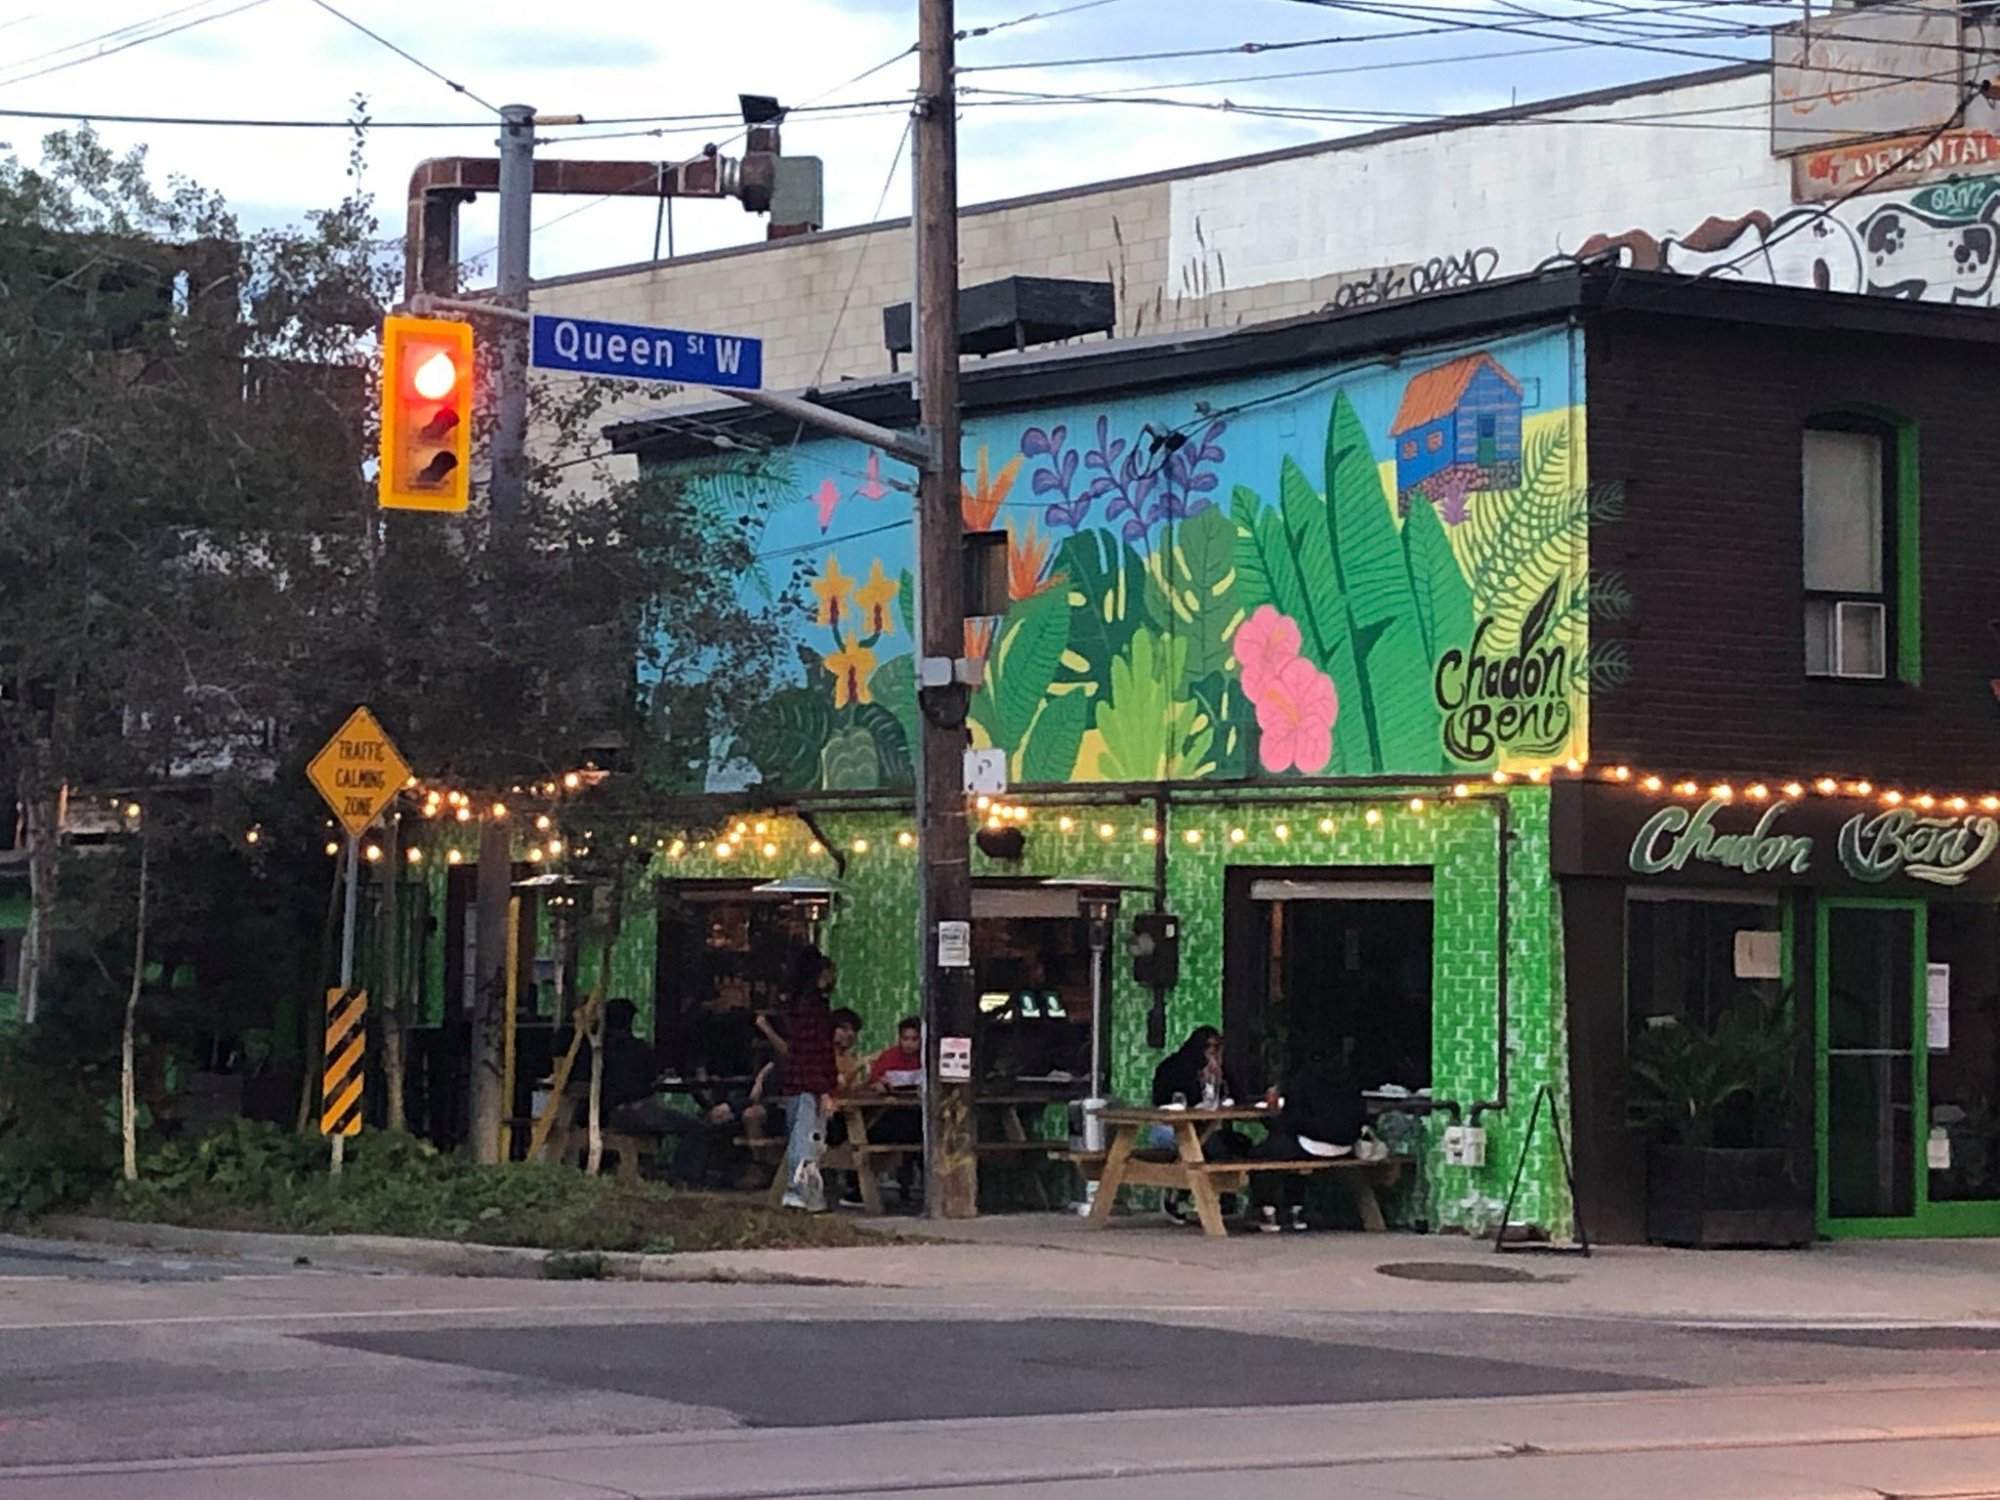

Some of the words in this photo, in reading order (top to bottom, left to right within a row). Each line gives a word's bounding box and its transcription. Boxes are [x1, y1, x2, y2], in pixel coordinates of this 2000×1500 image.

[554, 321, 673, 368] Queen
[687, 335, 705, 355] St
[715, 338, 742, 375] W
[1435, 574, 1565, 710] Chadon
[337, 740, 385, 762] TRAFFIC
[1444, 702, 1571, 762] Beni
[335, 768, 385, 790] CALMING
[343, 796, 374, 816] ZONE
[1630, 799, 1813, 874] Chadon
[1838, 808, 1999, 885] Beni
